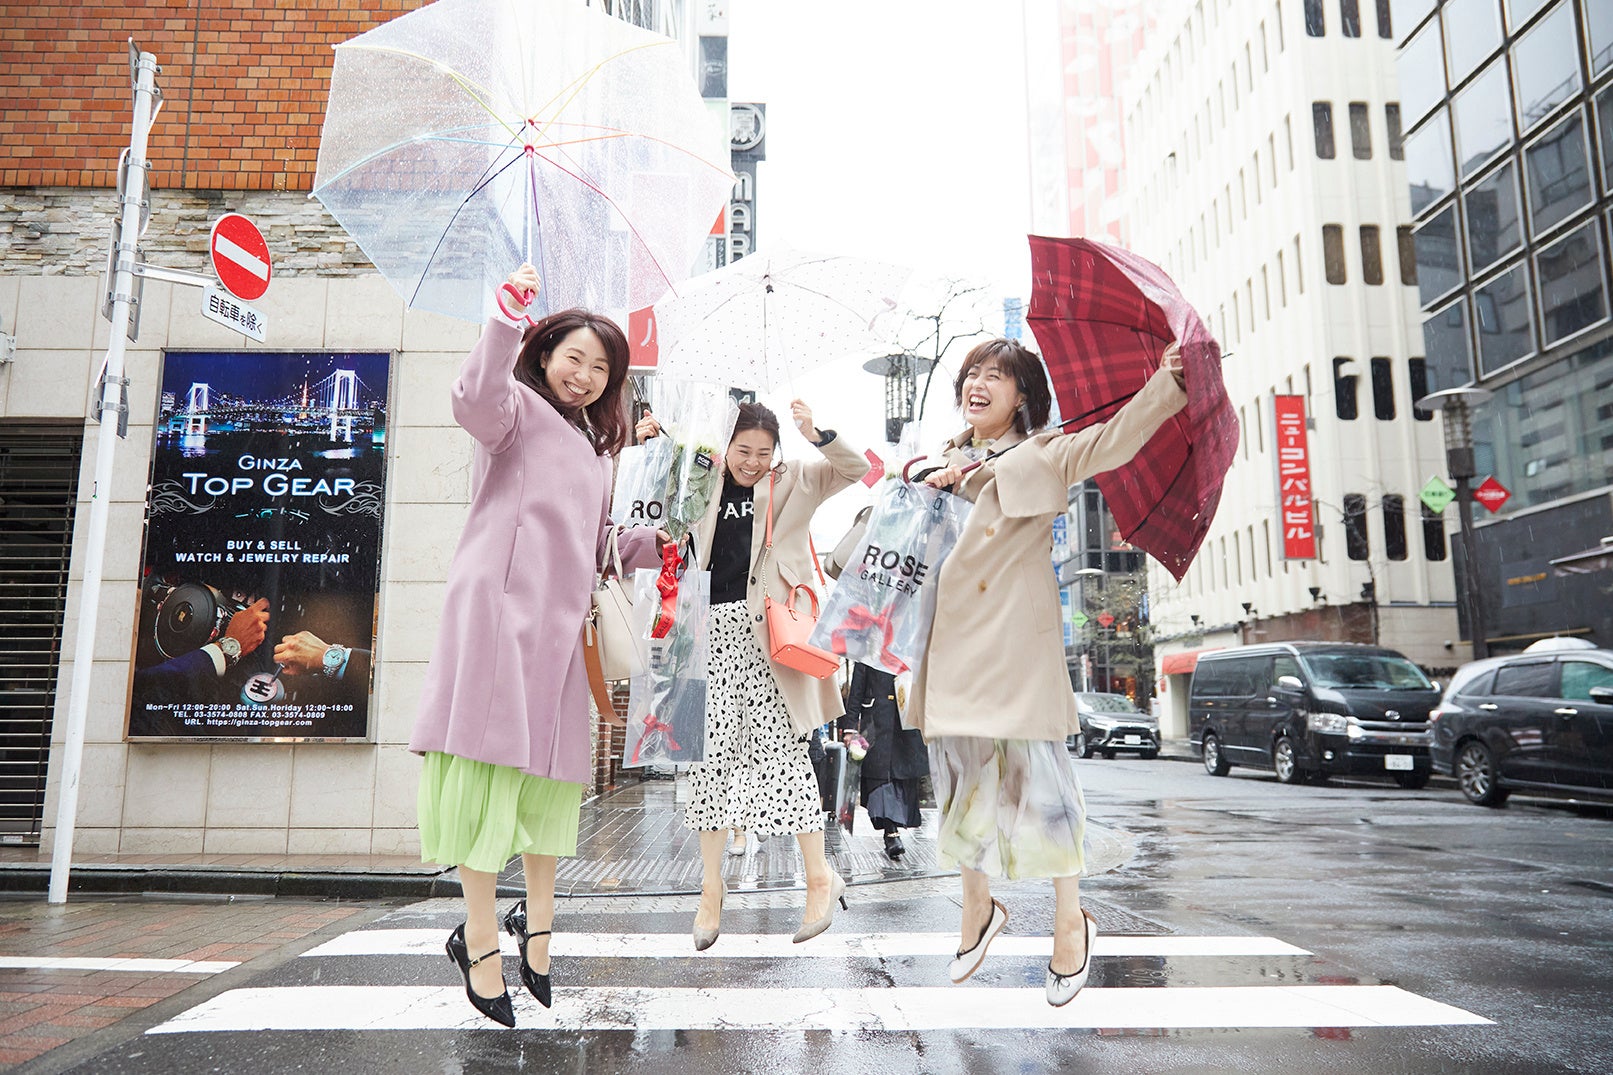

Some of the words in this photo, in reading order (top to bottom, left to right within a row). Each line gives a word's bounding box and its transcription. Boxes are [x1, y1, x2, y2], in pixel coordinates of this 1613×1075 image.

[209, 295, 262, 334] 自転車を除く
[182, 473, 254, 495] TOP
[263, 473, 356, 496] GEAR
[1280, 413, 1311, 539] ニューコンパルビル
[175, 552, 221, 562] WATCH
[226, 553, 235, 563] &
[239, 553, 299, 563] JEWELRY
[302, 553, 350, 563] REPAIR
[226, 540, 253, 550] BUY
[257, 540, 266, 550] &
[270, 540, 301, 550] SELL
[863, 545, 929, 585] ROSE
[860, 569, 917, 598] GALLERY
